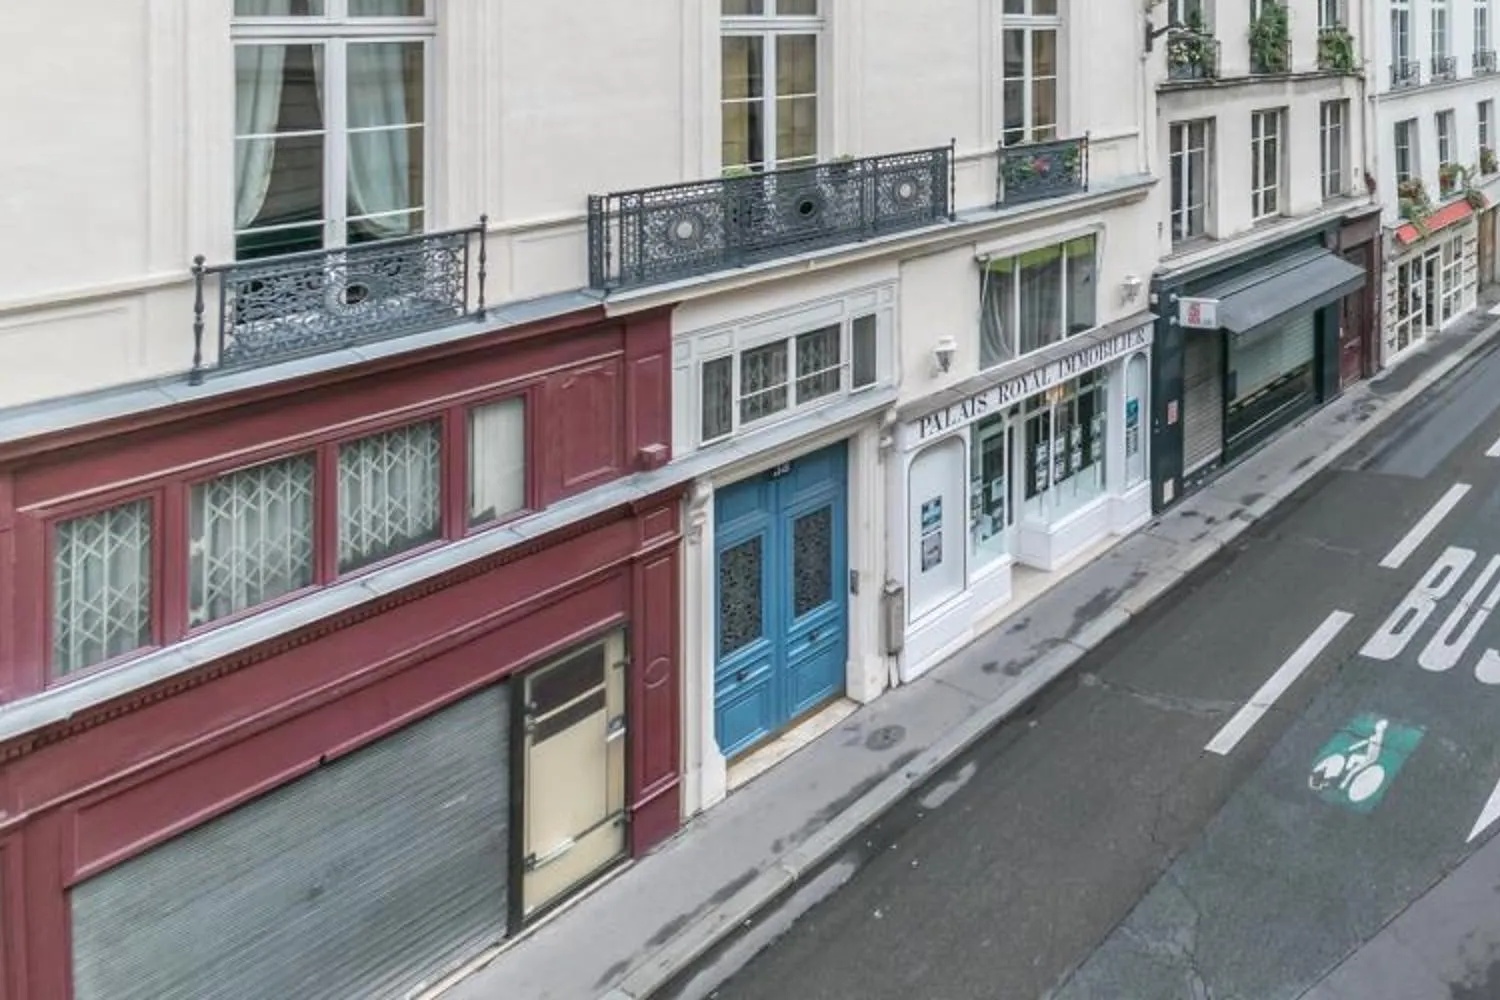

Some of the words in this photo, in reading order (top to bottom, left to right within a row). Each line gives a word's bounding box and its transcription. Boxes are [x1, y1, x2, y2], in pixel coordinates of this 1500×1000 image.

[919, 394, 987, 438] PALAIS
[998, 365, 1053, 405] ROYAL
[1059, 326, 1146, 379] IMMOBILIER
